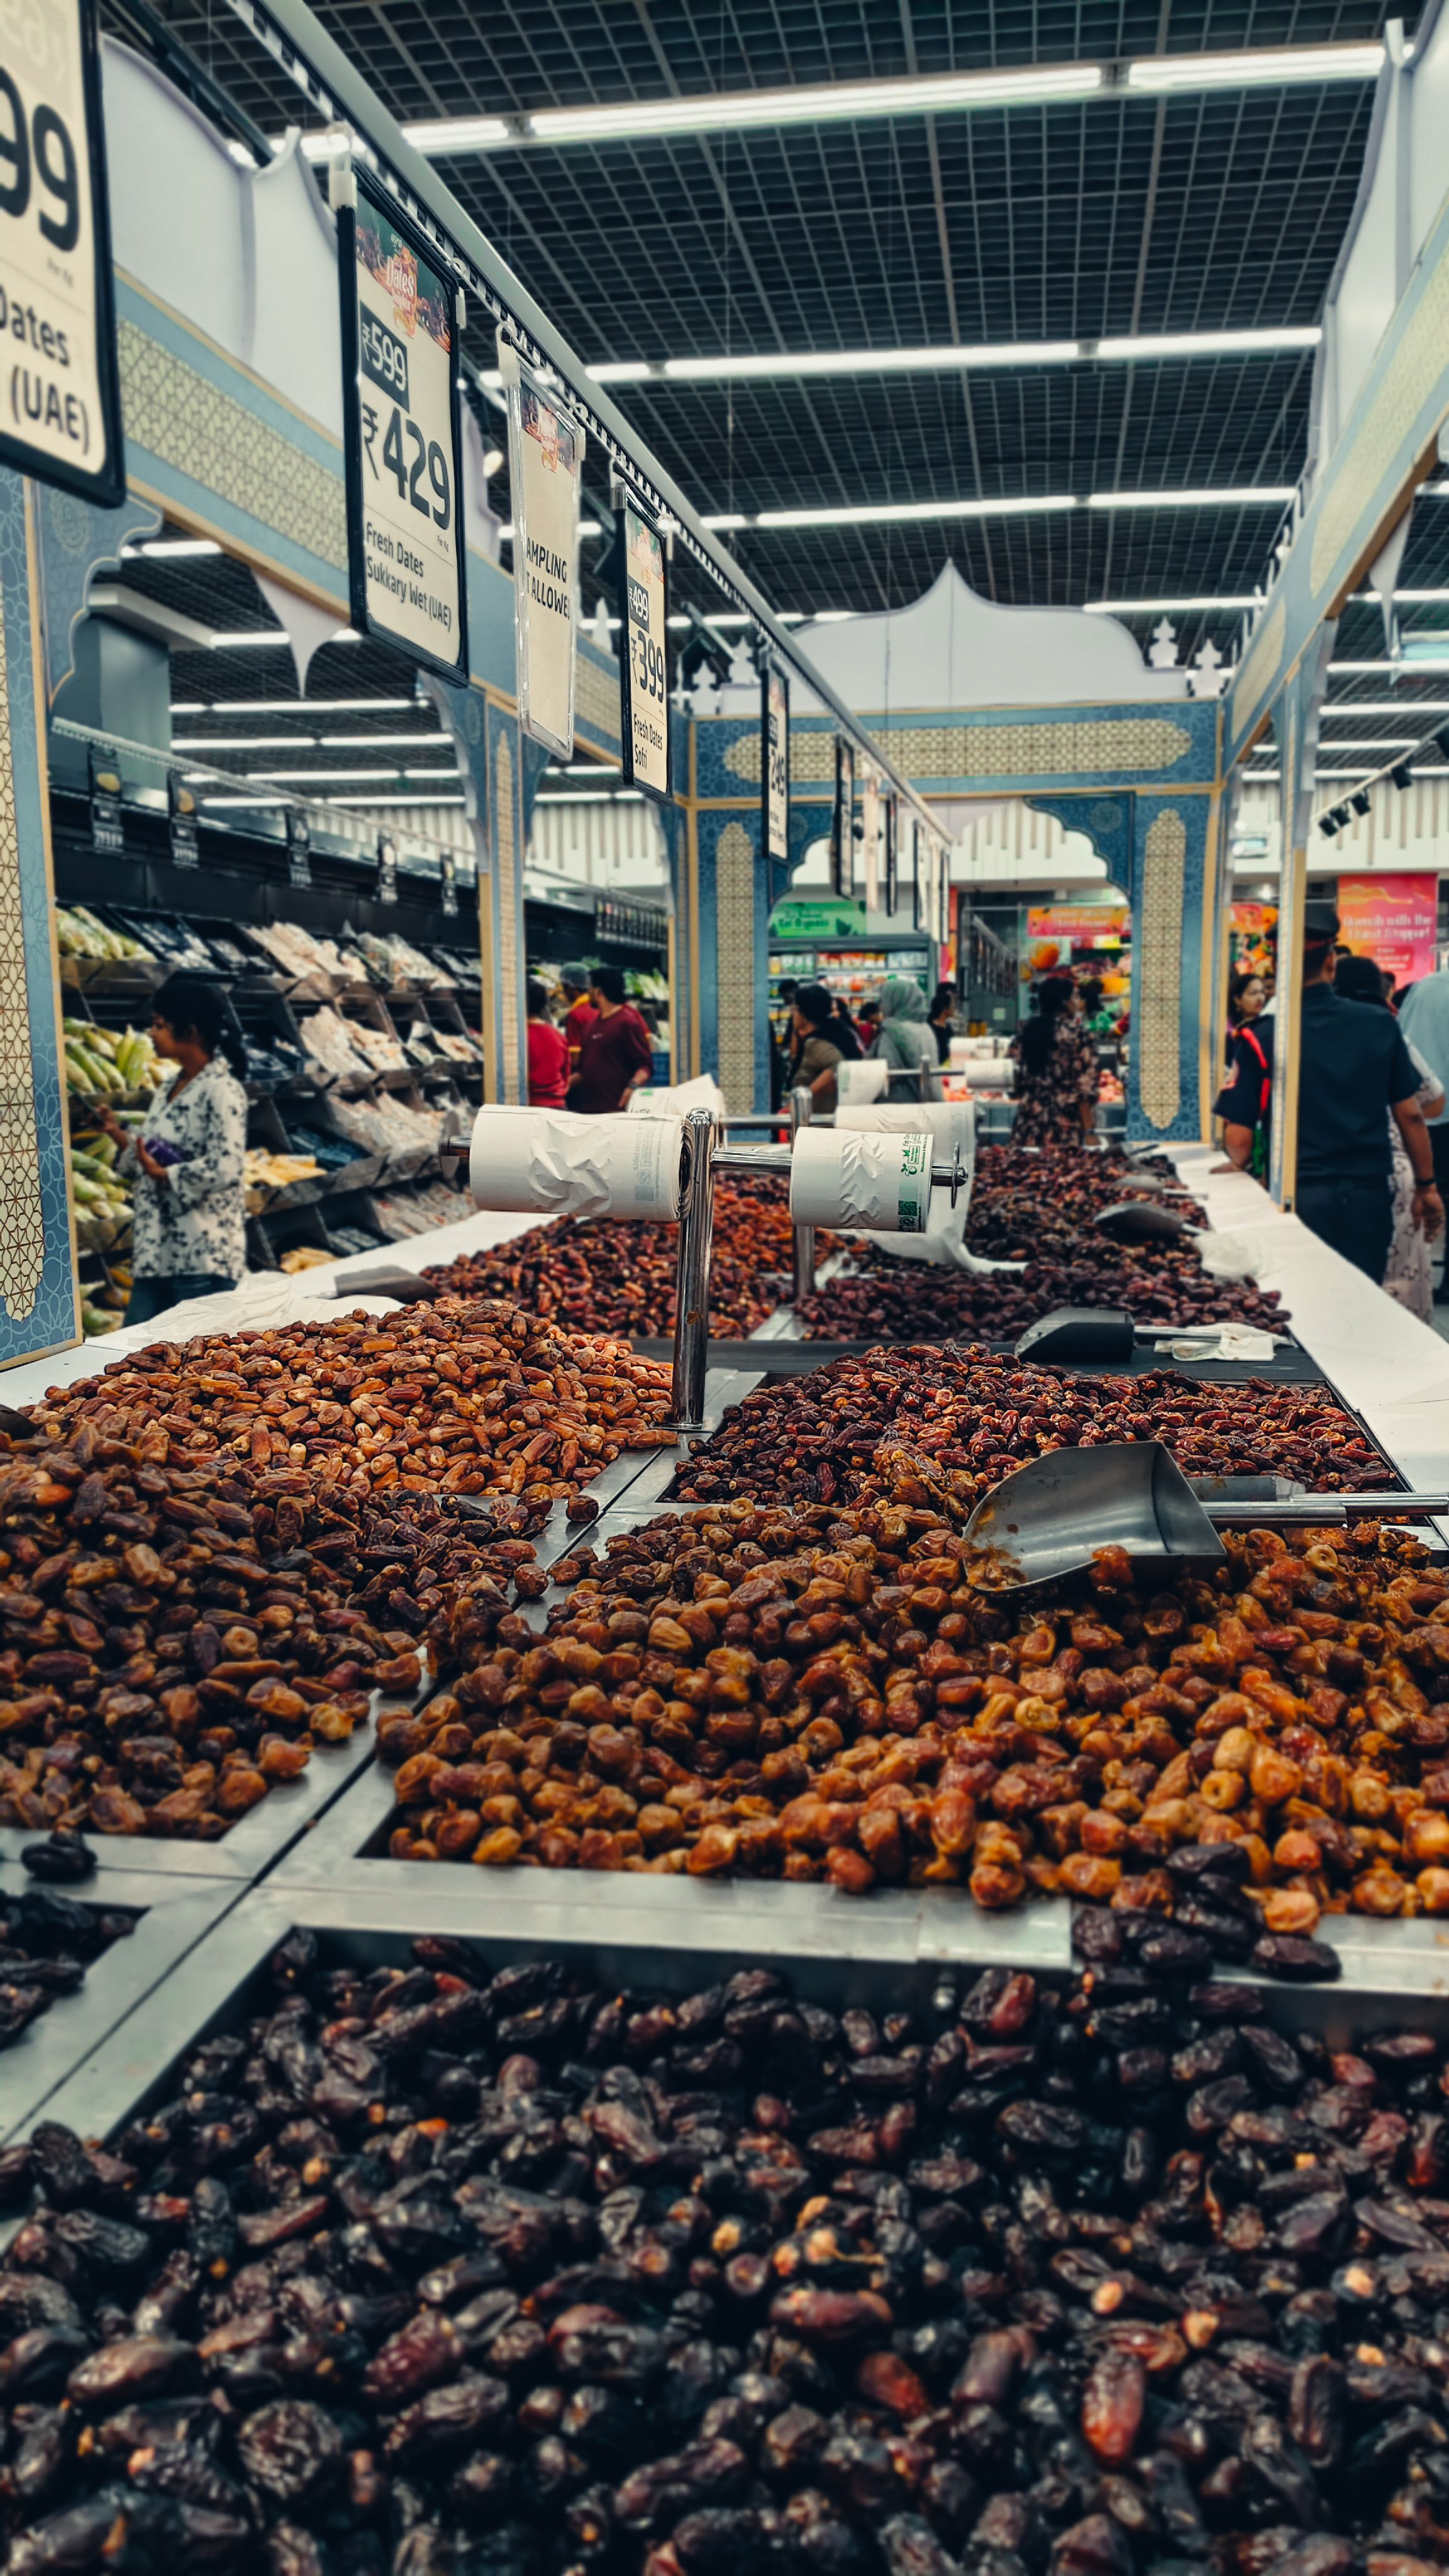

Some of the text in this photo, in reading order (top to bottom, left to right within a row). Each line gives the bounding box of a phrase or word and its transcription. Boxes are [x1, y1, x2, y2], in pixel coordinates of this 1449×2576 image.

[11, 364, 90, 456] (UAE)
[362, 402, 450, 530] ₹429
[366, 521, 425, 578] Fresh Dates
[526, 536, 567, 584] AMPLING
[366, 555, 452, 633] Sukkary Wet (UAE)
[631, 630, 664, 704] ₹399
[634, 713, 663, 752] Fresh Dates
[635, 743, 648, 770] Sofri
